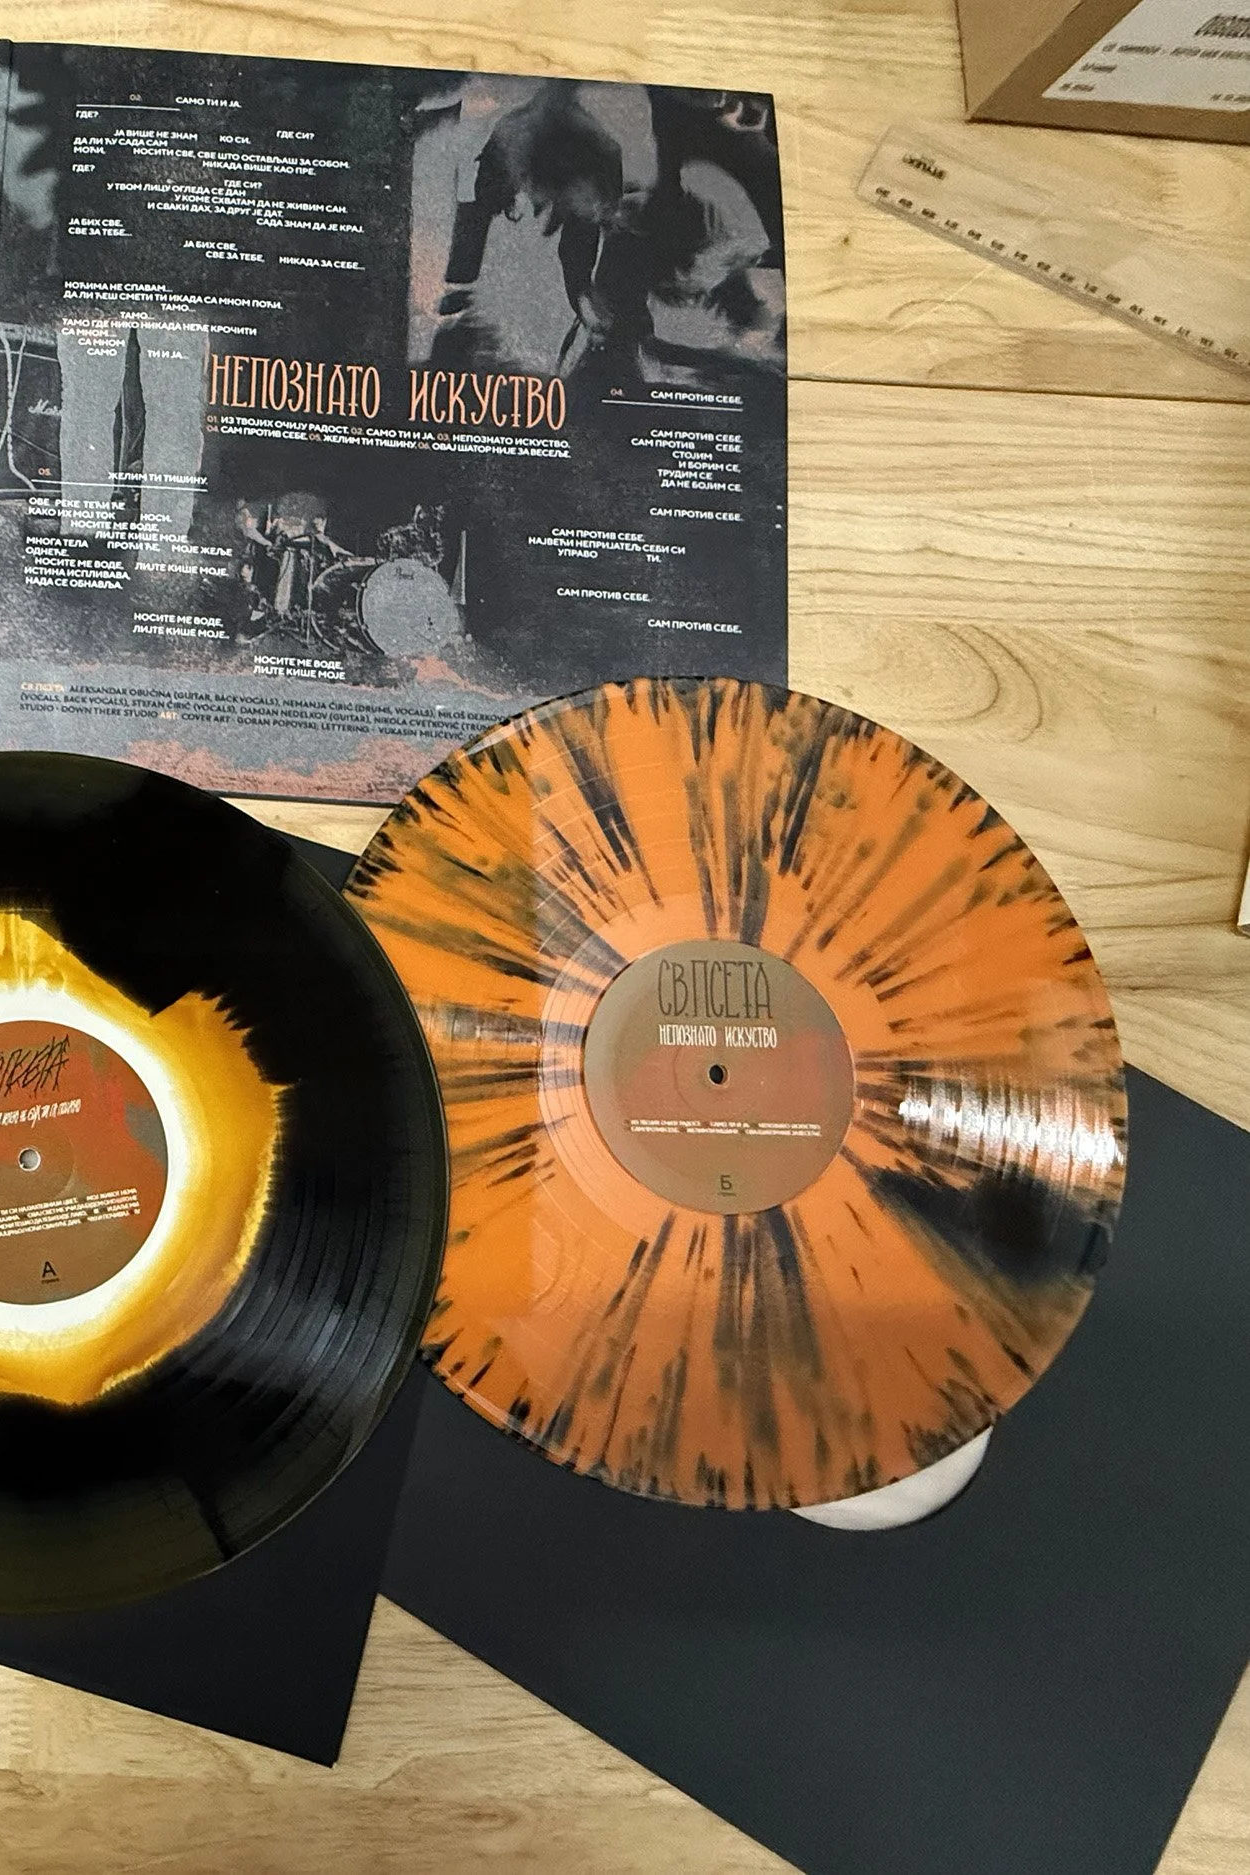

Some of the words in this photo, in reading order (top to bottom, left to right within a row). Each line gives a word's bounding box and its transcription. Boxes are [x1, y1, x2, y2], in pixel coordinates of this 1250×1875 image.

[175, 97, 205, 105] САМО
[76, 110, 99, 119] ГДЕ?
[220, 135, 233, 143] КО
[276, 130, 294, 139] ГДЕ
[279, 257, 320, 267] НИКАДА
[209, 354, 381, 419] НЕПОЗНАТО
[408, 369, 567, 431] ИСКУСТВО
[651, 391, 673, 399] САМ
[675, 392, 714, 402] ПРОТИВ
[221, 416, 234, 427] ИЗ
[236, 417, 273, 428] ТВОЈИХ
[274, 421, 307, 430] ОЧИЈУ
[366, 428, 397, 437] САМО
[398, 430, 411, 438] ТИ
[453, 434, 513, 445] НЕПОЗНАТО
[672, 451, 713, 460] СТОЈИМ
[688, 461, 724, 471] БОРИМ
[107, 472, 148, 482] ЖЕЛИМ
[149, 474, 162, 482] ТИ
[657, 469, 697, 479] ТРУДИМ
[699, 472, 712, 480] СЕ
[661, 479, 676, 488] ДА
[677, 480, 690, 488] НЕ
[692, 481, 726, 490] БОЈИМ
[529, 537, 574, 547] НАЈВЕЋИ
[576, 540, 641, 551] НЕПРИЈАТЕЉ
[642, 544, 669, 553] СЕБИ
[670, 546, 685, 554] СИ
[558, 549, 598, 558] УПРАВО
[134, 613, 175, 623] НОСИТЕ
[177, 616, 192, 624] МЕ
[133, 625, 164, 635] ЛИЈТЕ
[166, 627, 196, 637] КИШЕ
[19, 703, 54, 712] STUDIO
[61, 706, 92, 714] DOWN
[94, 707, 121, 716] THERE
[124, 709, 158, 719] STUDIO
[181, 713, 211, 722] COVER
[214, 715, 230, 723] ART
[658, 959, 773, 1019] СВ.ПСЕТА
[659, 1025, 717, 1047] НЕПОЗНАТО
[725, 1026, 778, 1048] ИСКУСТВО
[720, 1175, 733, 1190] Б
